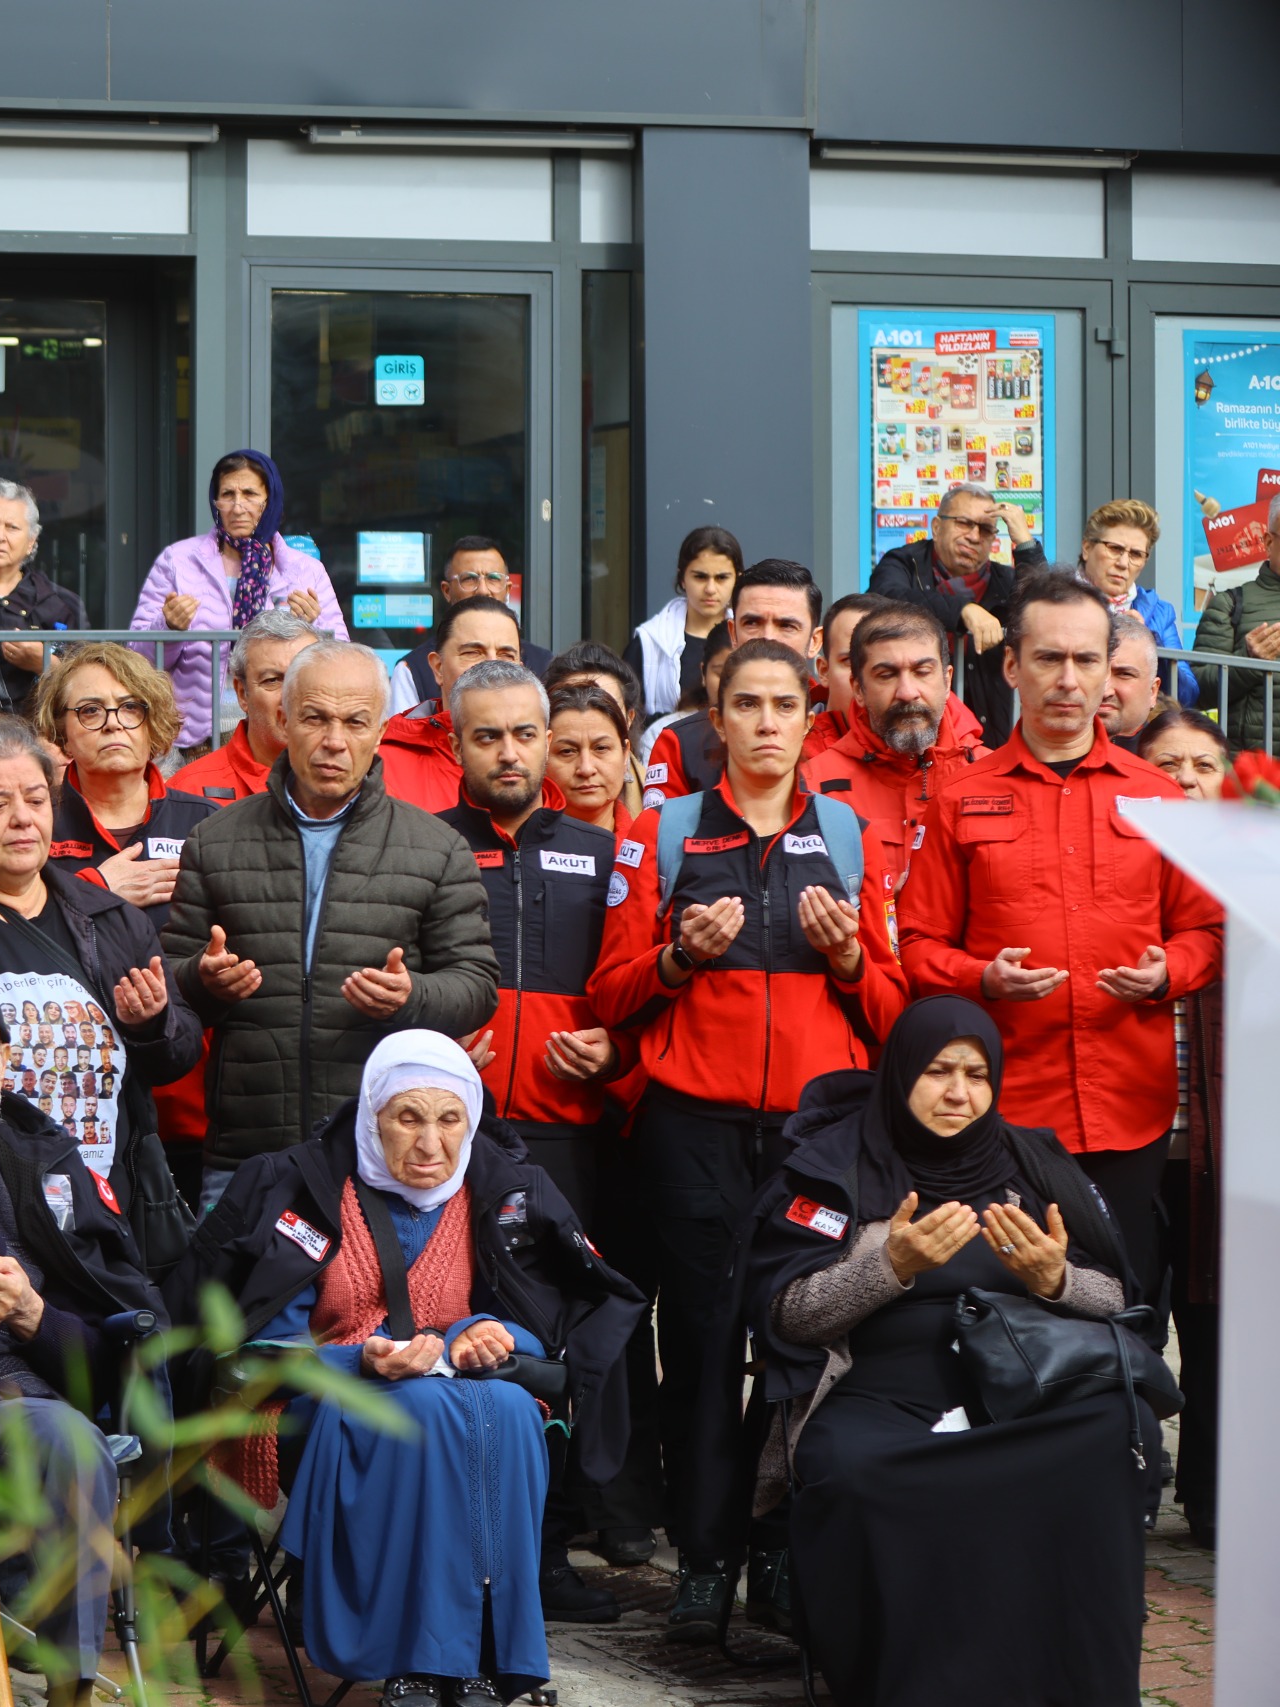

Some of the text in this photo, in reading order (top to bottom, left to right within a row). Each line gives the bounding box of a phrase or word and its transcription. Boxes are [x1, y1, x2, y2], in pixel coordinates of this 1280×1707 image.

[940, 333, 990, 343] HAFTANIN
[939, 342, 991, 352] YILDIZLARI
[384, 360, 417, 378] GİRİŞ
[1216, 402, 1272, 414] Ramazanın
[1225, 417, 1280, 432] birlikte büy
[646, 769, 662, 780] KUT
[155, 843, 182, 855] AKU
[791, 839, 823, 849] AKU
[548, 856, 588, 869] AKUT
[279, 1220, 297, 1233] ARAMA
[300, 1221, 326, 1241] TURGAY
[814, 1220, 838, 1233] KAYA
